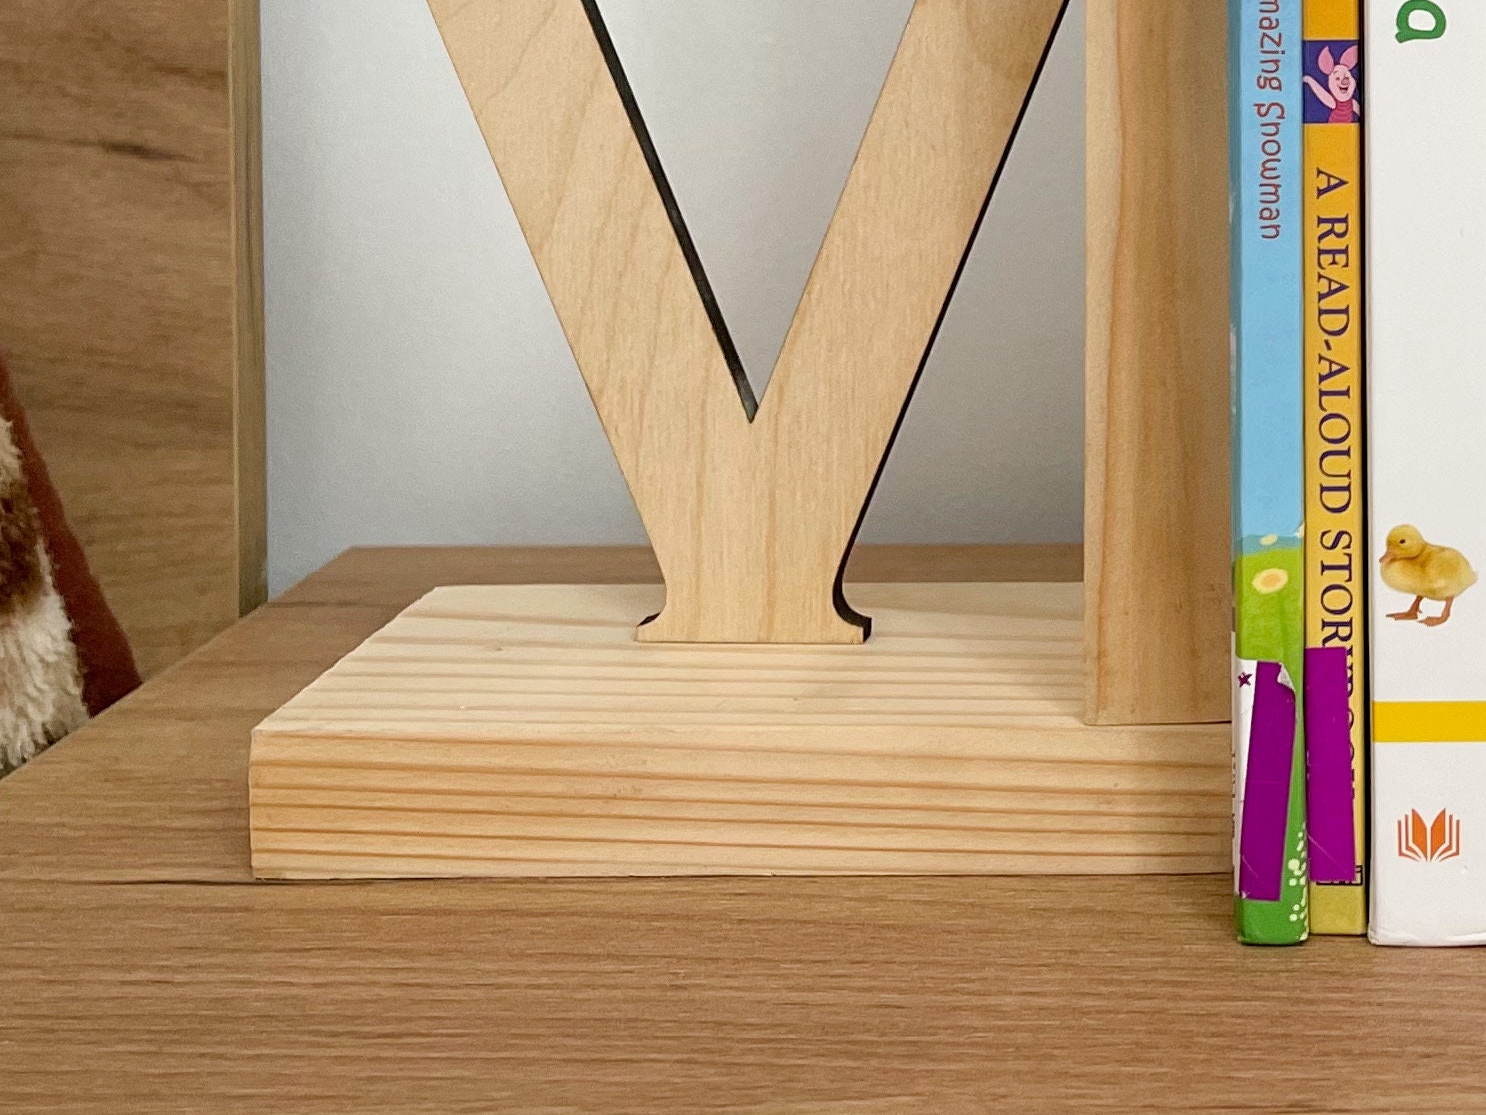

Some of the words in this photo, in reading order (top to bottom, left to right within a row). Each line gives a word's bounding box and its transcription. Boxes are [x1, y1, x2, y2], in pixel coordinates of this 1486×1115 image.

[1254, 101, 1285, 240] Snowman
[1316, 167, 1349, 199] A
[1316, 212, 1352, 514] READ-ALOUD
